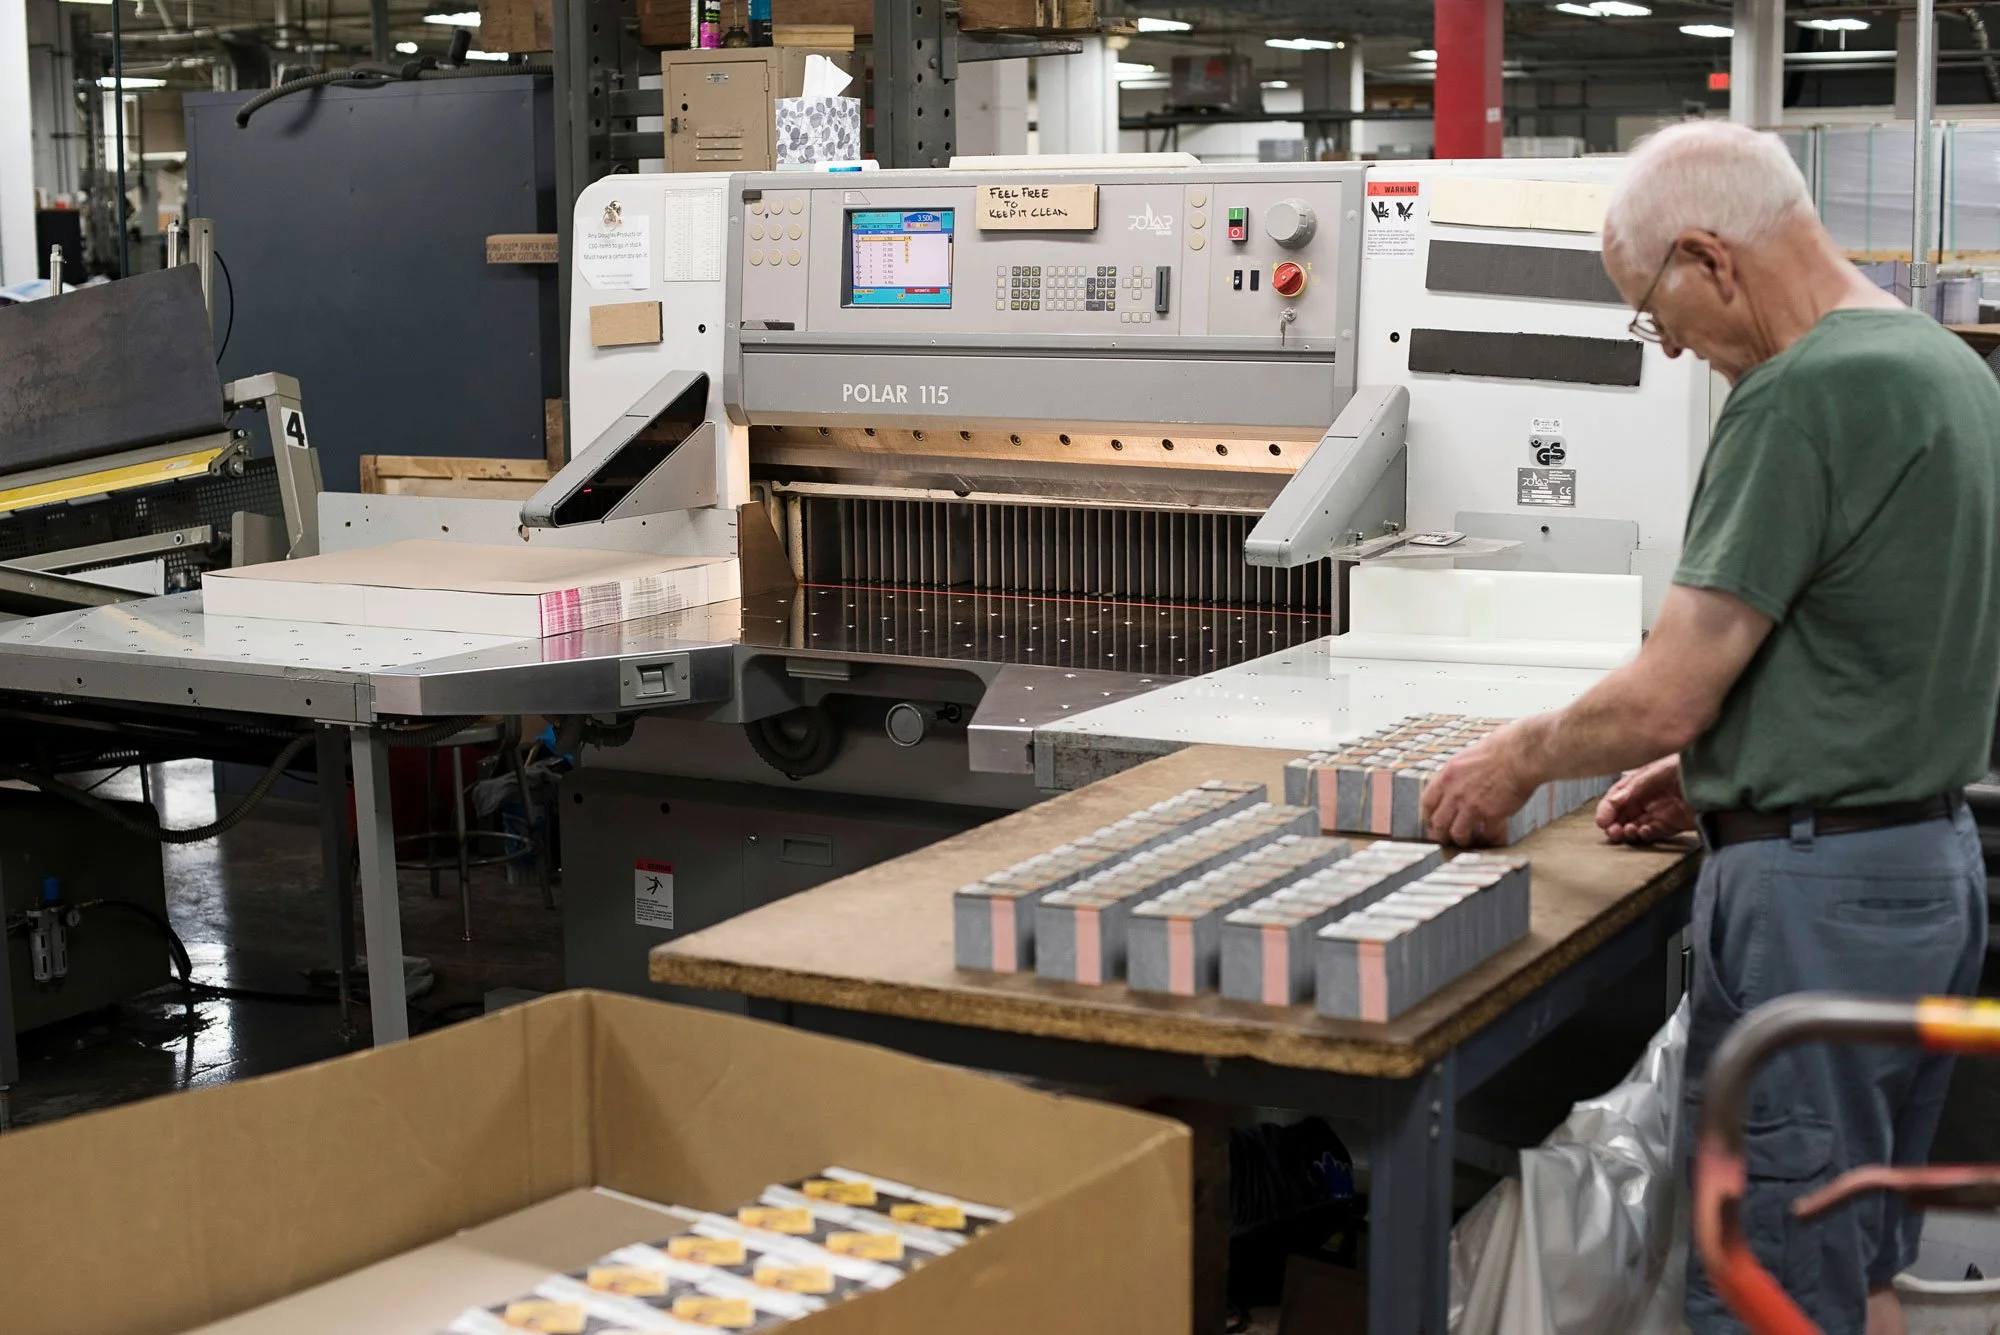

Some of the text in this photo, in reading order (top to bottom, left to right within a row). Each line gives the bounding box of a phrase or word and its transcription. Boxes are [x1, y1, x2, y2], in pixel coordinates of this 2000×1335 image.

[990, 187, 1048, 199] FEEL FREE
[1384, 186, 1416, 194] WARNING
[1004, 200, 1018, 208] TO
[917, 214, 933, 222] 3.500
[989, 209, 1015, 218] KEEP
[1031, 208, 1068, 217] CLEAN
[520, 242, 540, 251] PAPER
[518, 252, 542, 261] CUTTING
[842, 383, 949, 404] POLAR 115
[286, 411, 304, 446] 4
[1536, 442, 1566, 466] GS
[1560, 486, 1572, 496] CE
